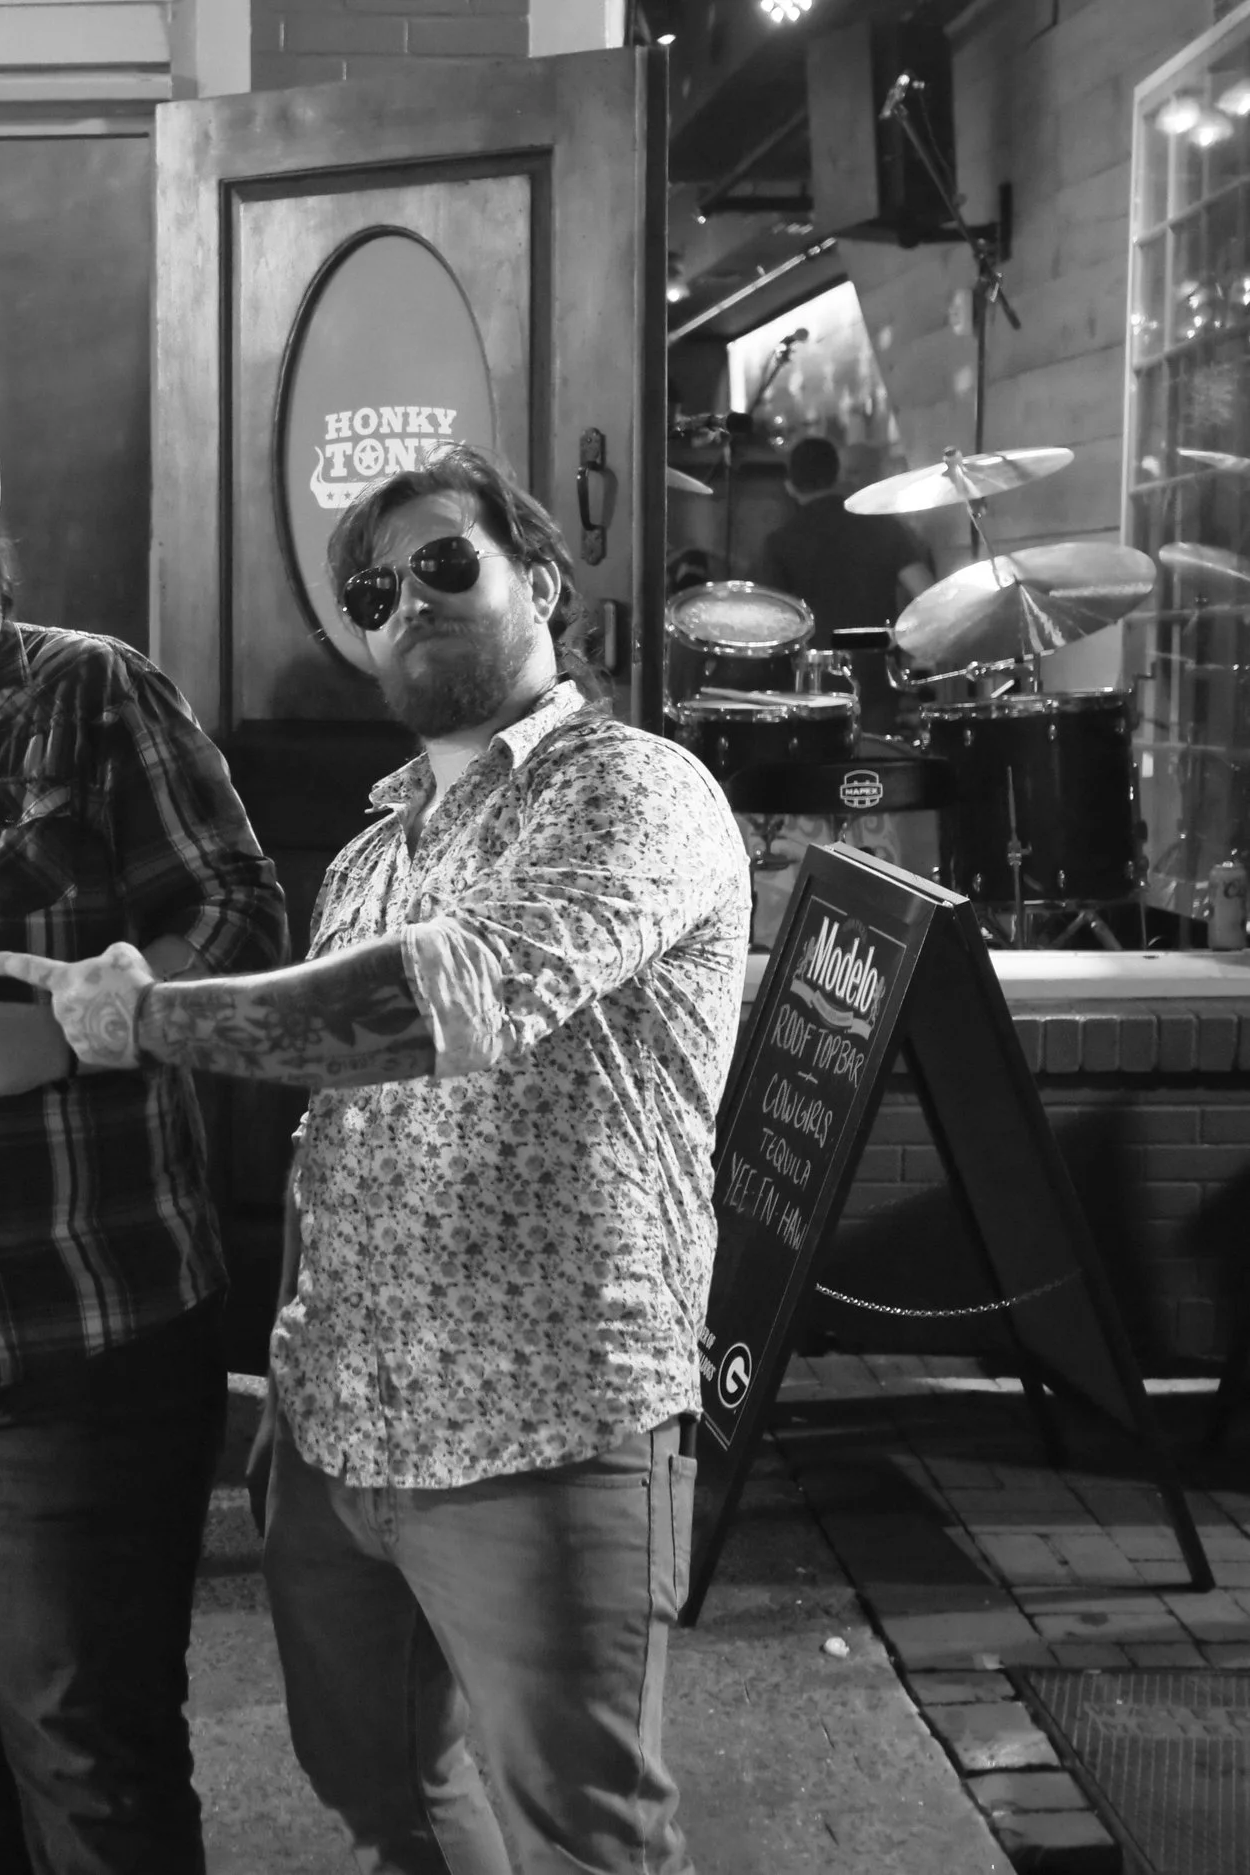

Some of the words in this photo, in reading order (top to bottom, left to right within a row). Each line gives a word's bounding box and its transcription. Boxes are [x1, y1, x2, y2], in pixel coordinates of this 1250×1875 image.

[325, 406, 457, 440] HONKY
[806, 915, 878, 1014] Modelo
[770, 1003, 817, 1059] ROOF
[762, 1072, 833, 1148] COWGIRLS
[759, 1127, 812, 1192] TEQUILA
